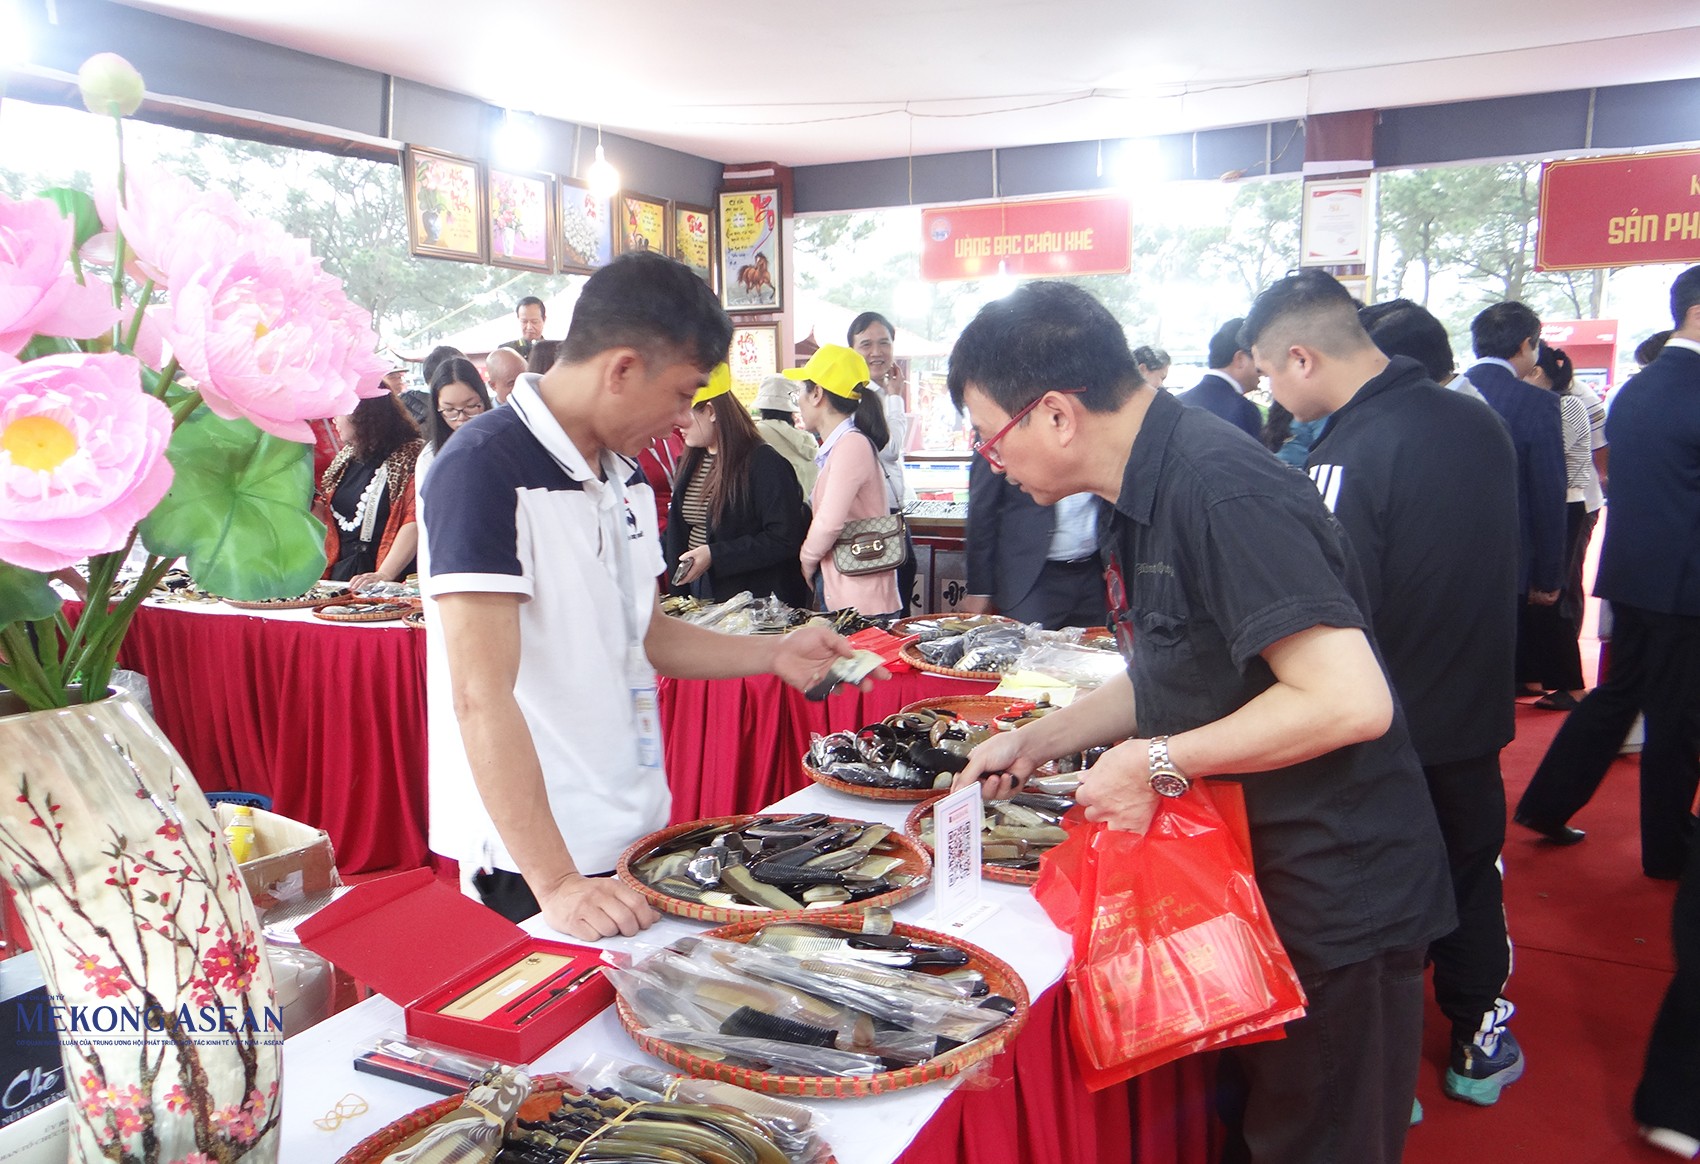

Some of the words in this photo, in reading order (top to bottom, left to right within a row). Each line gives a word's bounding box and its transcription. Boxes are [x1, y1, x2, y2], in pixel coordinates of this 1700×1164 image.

[955, 234, 991, 258] VÀNG
[993, 235, 1021, 258] BẠC
[1024, 231, 1061, 254] CHÂU
[1064, 228, 1094, 251] KHÊ
[1608, 207, 1659, 245] SẢN
[1664, 211, 1700, 241] PH
